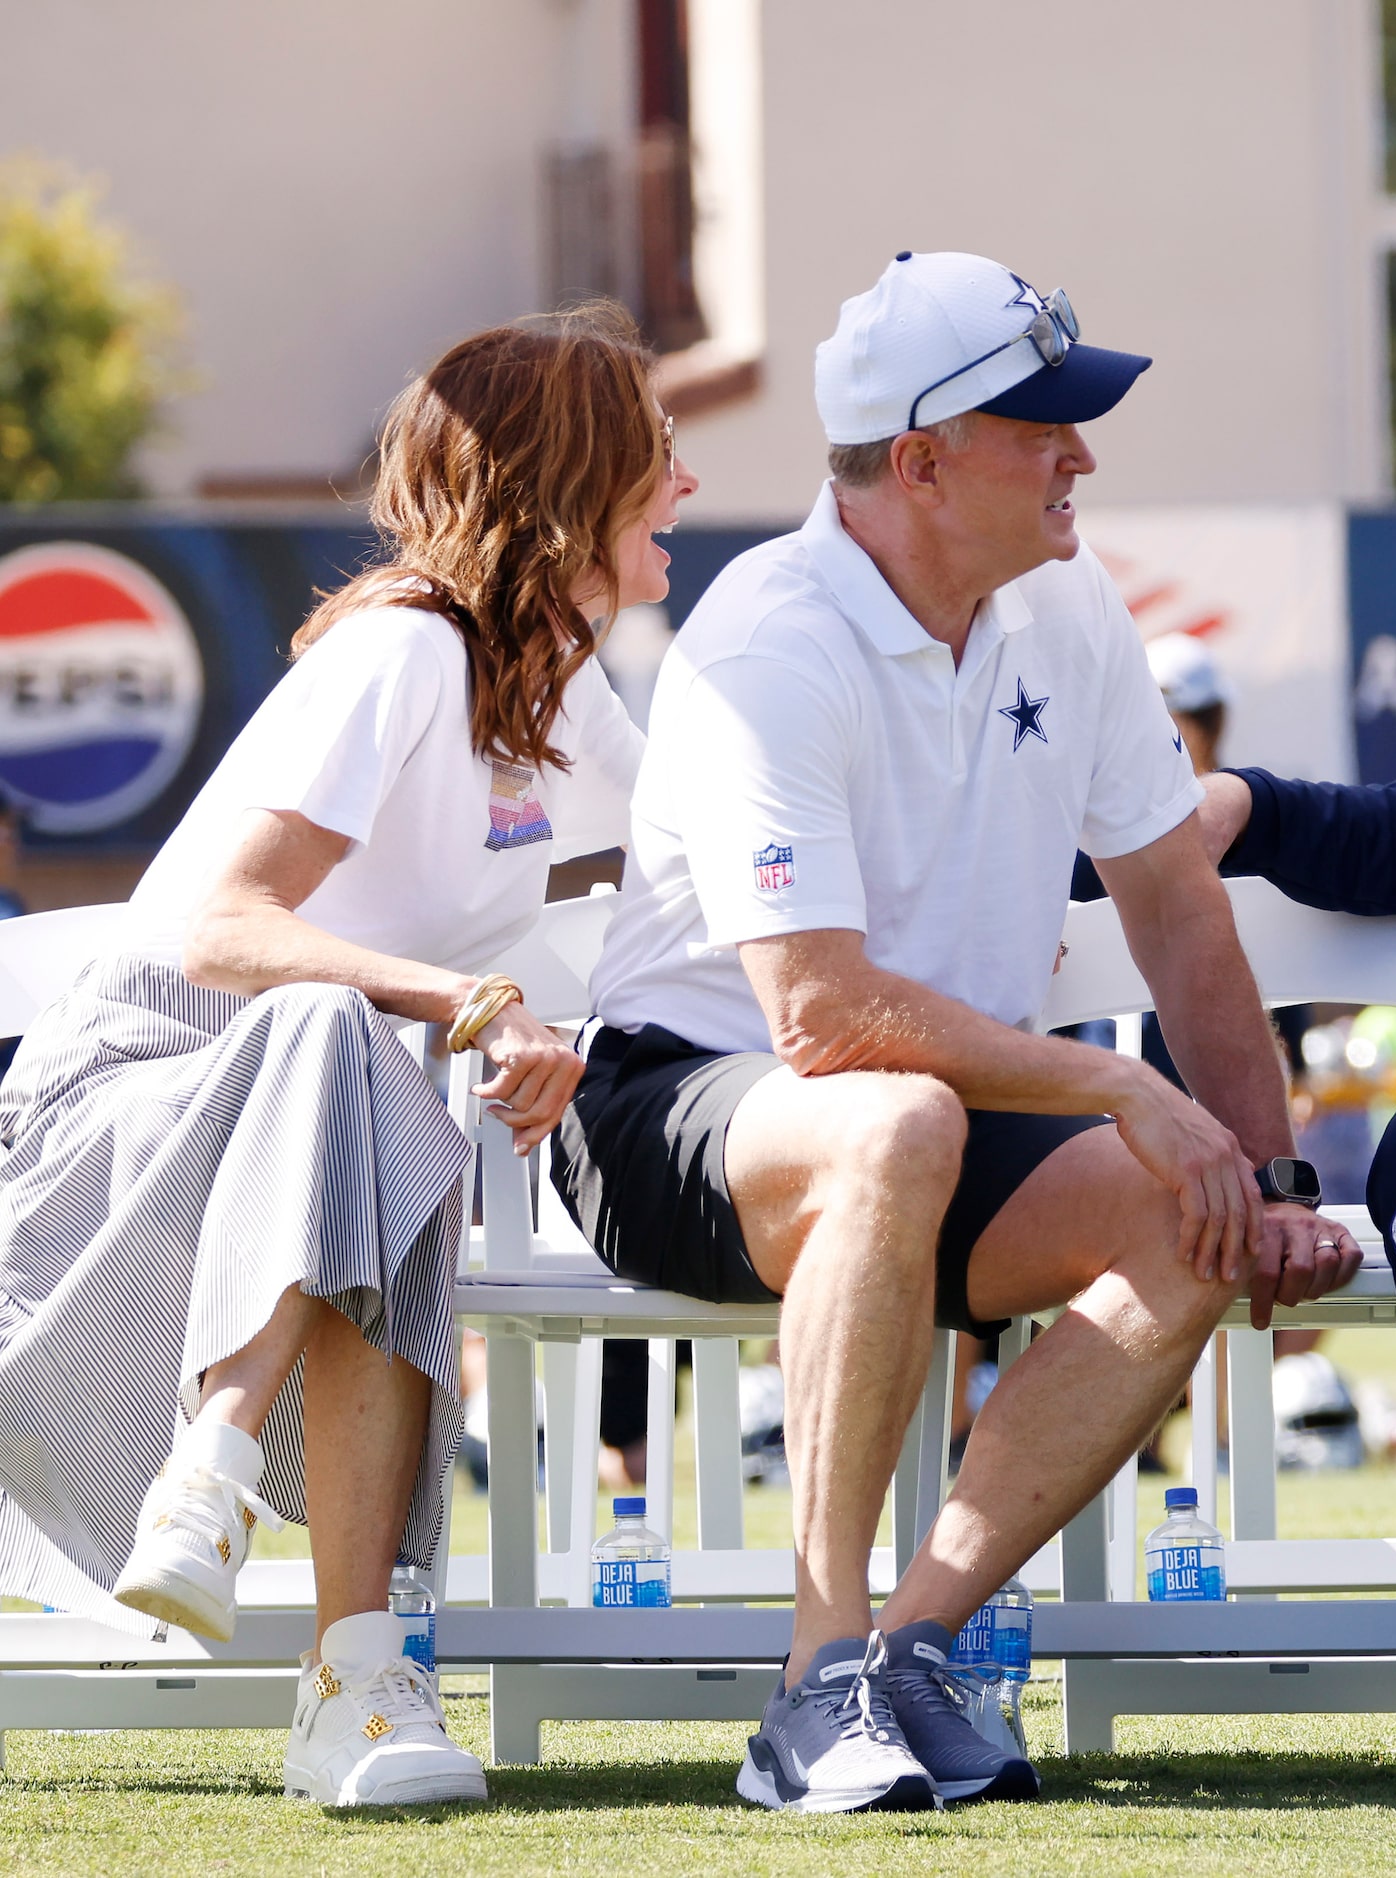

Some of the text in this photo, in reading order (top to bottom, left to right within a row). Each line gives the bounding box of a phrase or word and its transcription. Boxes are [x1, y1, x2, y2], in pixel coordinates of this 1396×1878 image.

[757, 863, 793, 889] NFL
[1165, 1549, 1198, 1570] DEJA
[602, 1564, 633, 1584] DEJA
[1166, 1568, 1200, 1591] BLUE
[603, 1584, 634, 1605] BLUE
[958, 1630, 992, 1651] BLUE
